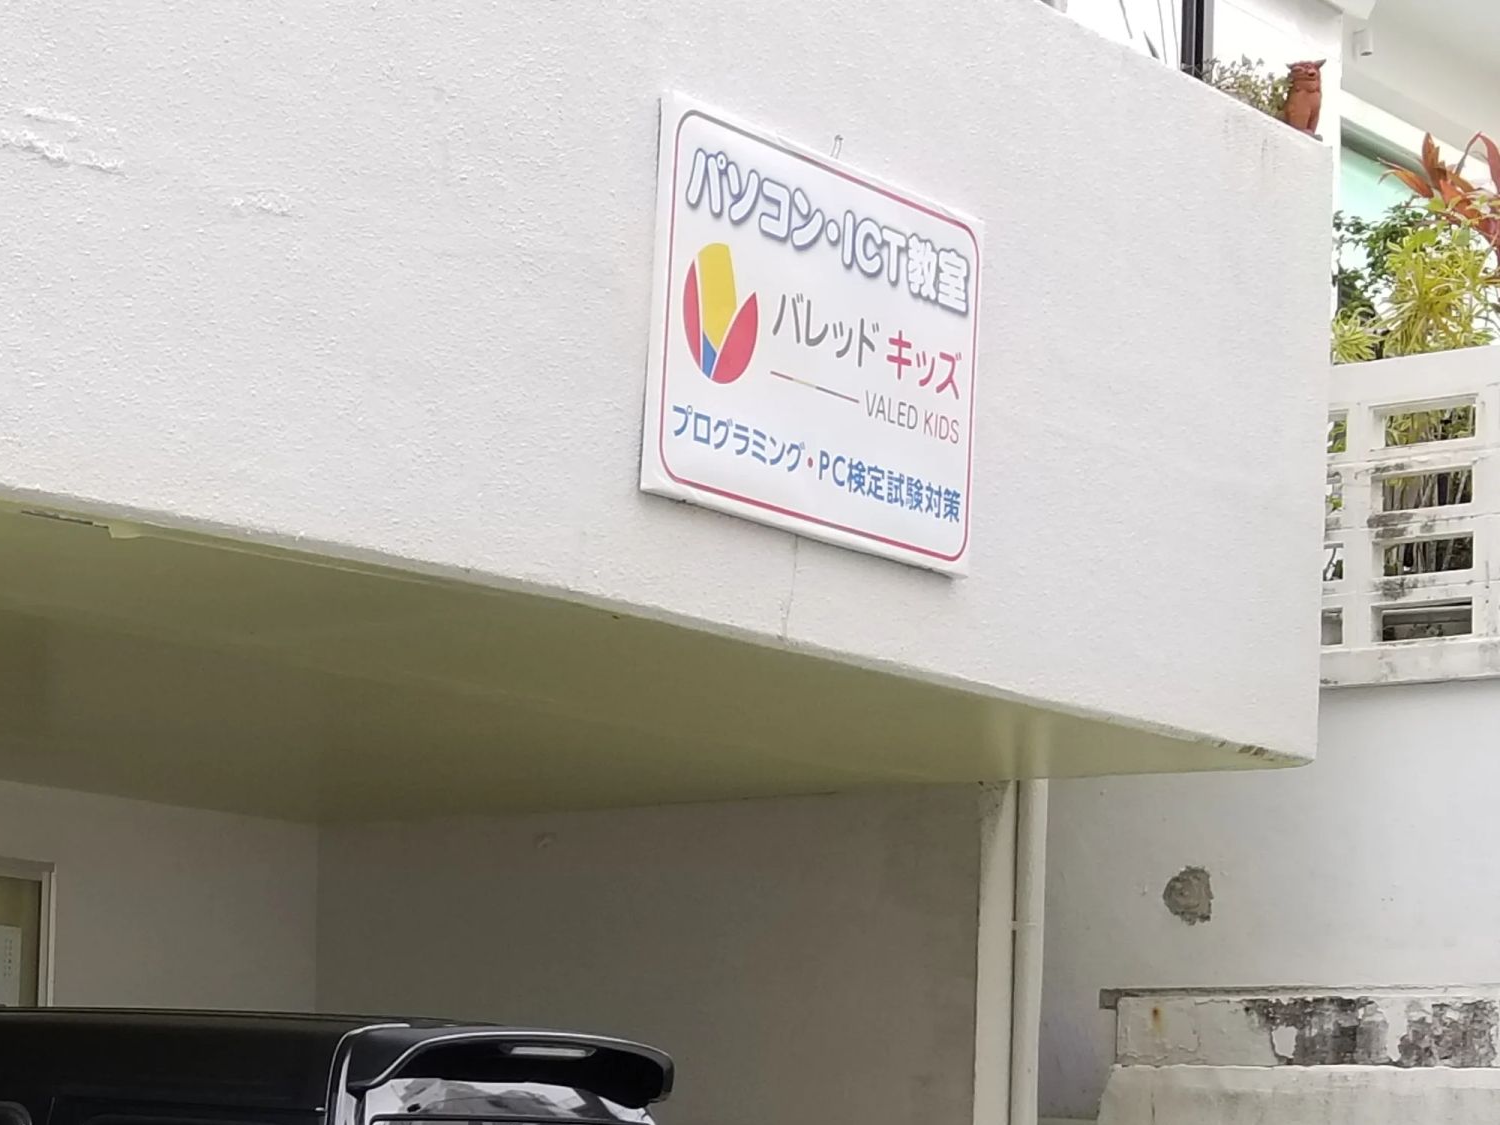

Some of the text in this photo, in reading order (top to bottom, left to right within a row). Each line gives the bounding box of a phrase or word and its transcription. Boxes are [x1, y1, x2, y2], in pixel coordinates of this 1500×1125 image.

[686, 147, 970, 316] パソコン・ICT教室
[773, 293, 963, 400] バレッド キッズ
[672, 404, 962, 522] プログラミング・PC検定試験対策
[865, 389, 961, 445] VALED KIDS
